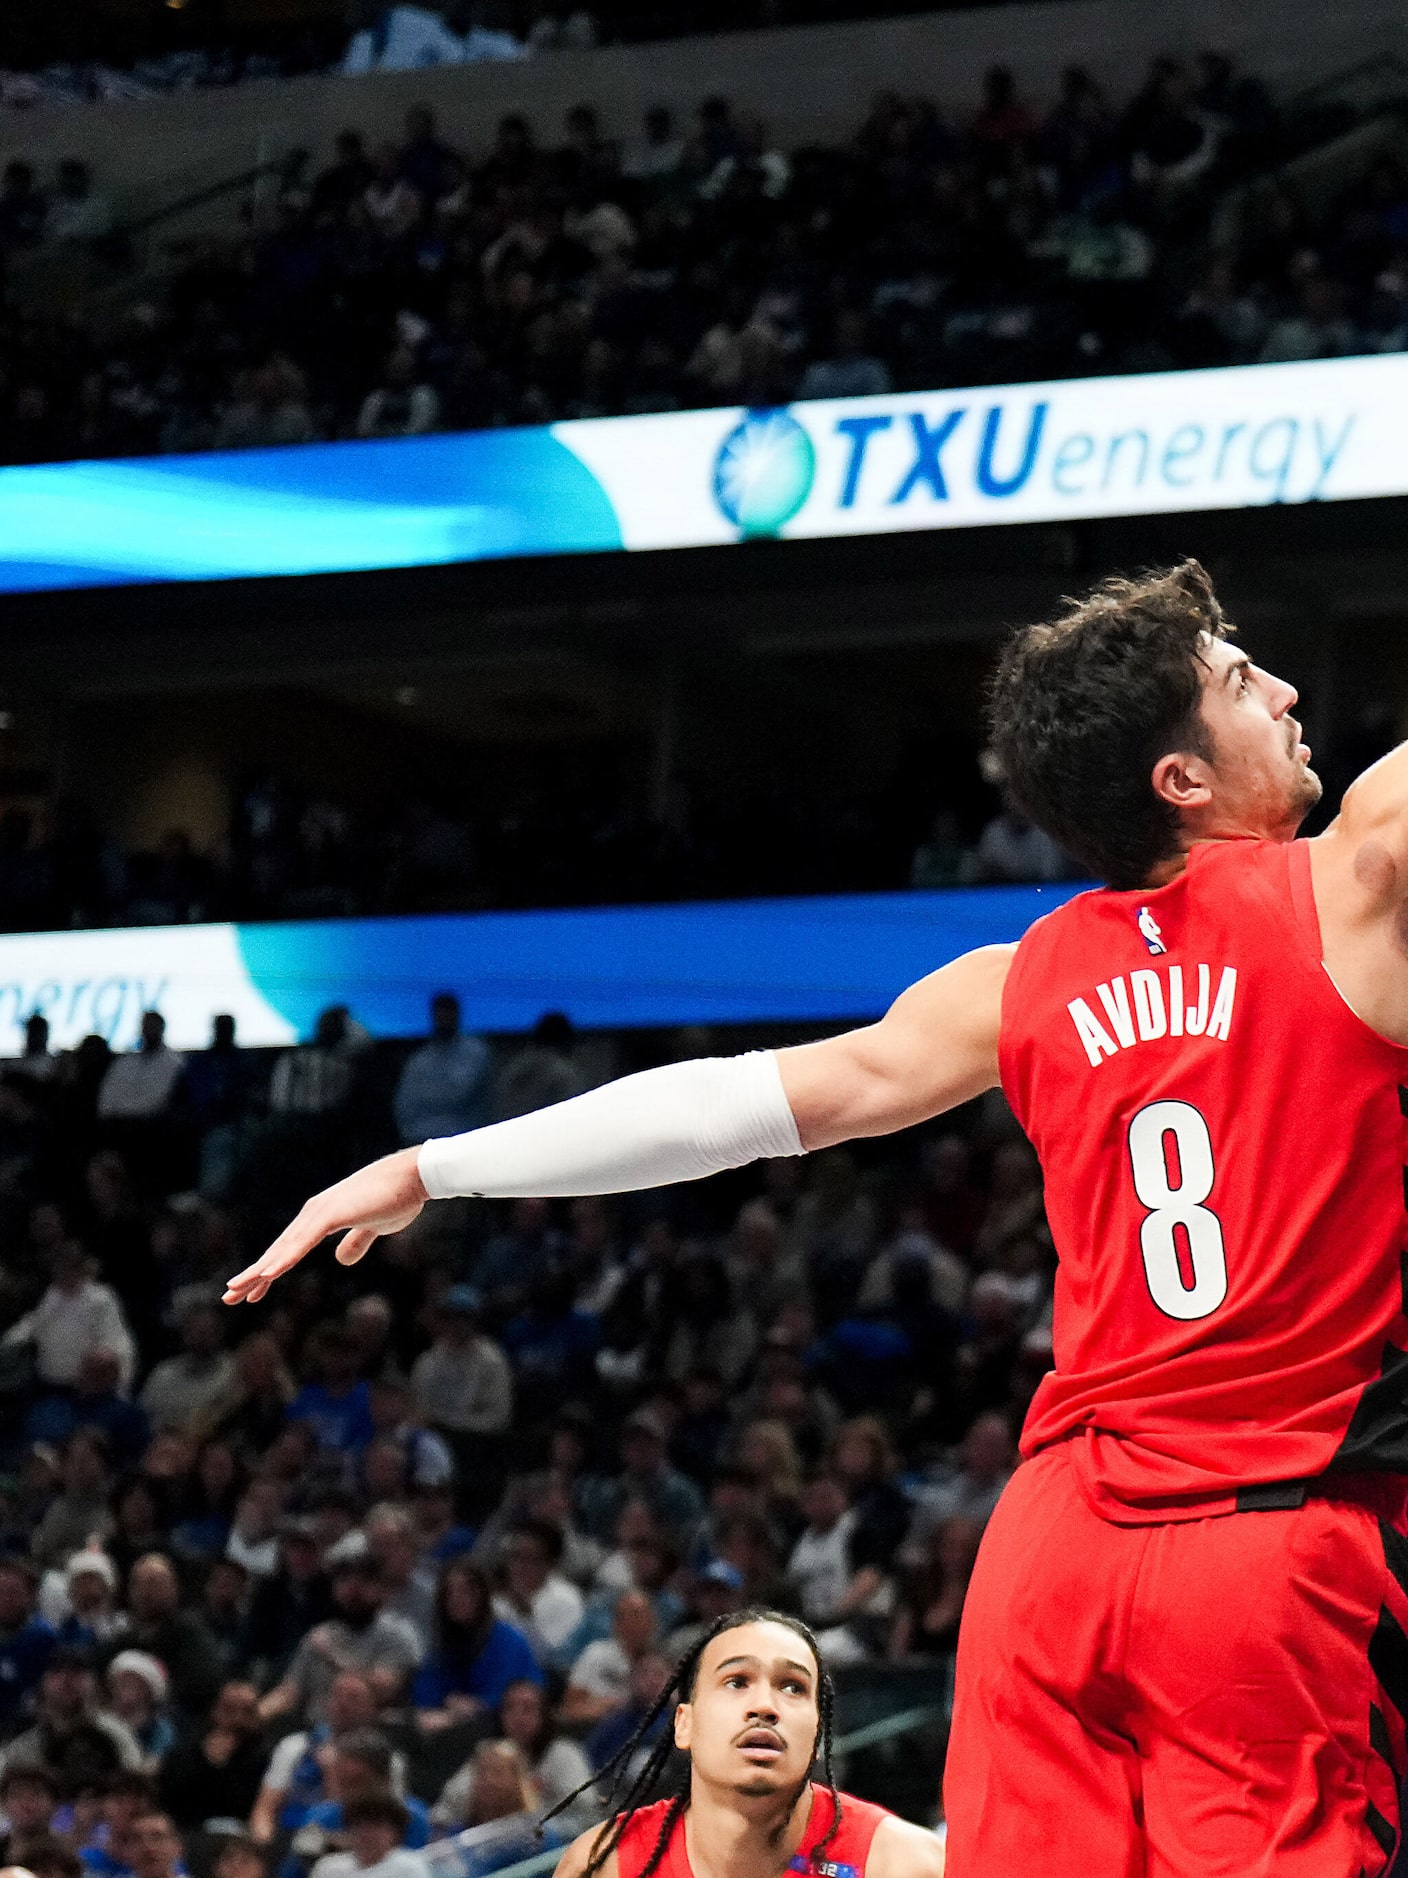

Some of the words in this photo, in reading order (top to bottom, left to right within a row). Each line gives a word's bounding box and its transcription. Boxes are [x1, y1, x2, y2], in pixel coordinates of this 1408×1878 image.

[834, 402, 1048, 508] TXU
[1052, 414, 1356, 505] energy
[1067, 963, 1238, 1068] AVDIJA
[1128, 1099, 1229, 1322] 8
